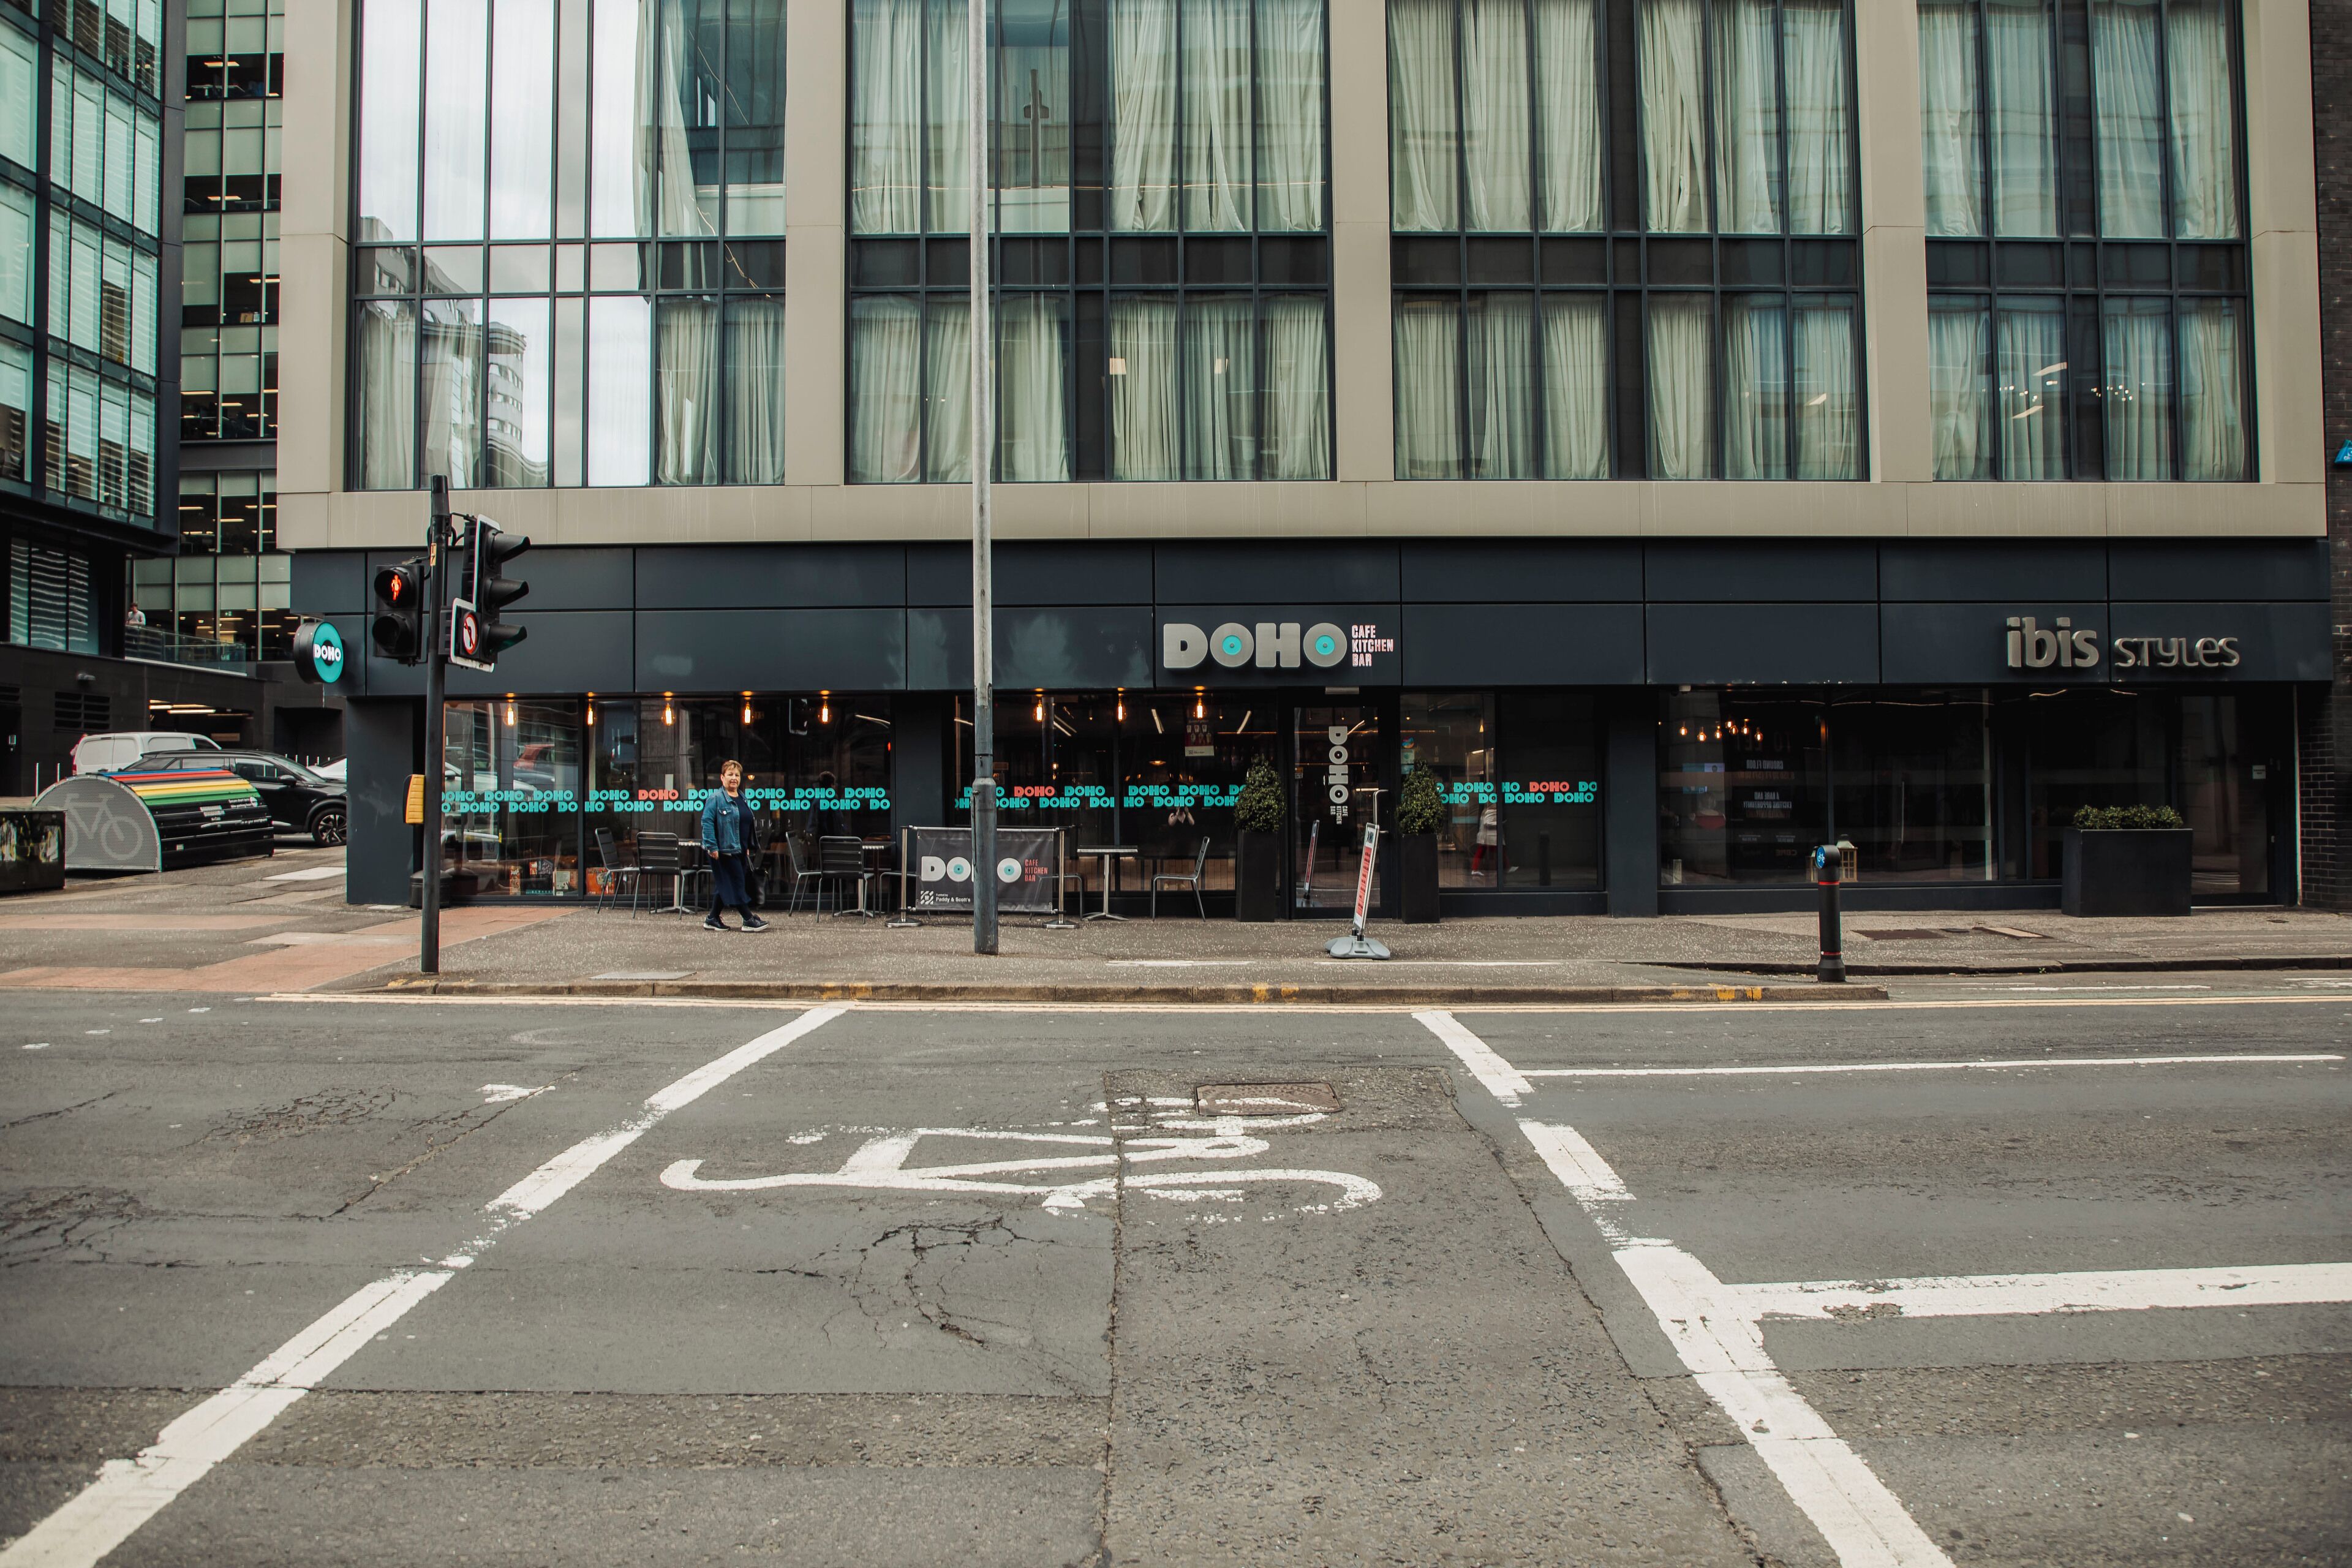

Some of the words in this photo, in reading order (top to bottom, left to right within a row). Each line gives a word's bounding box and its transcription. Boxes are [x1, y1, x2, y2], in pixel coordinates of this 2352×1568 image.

[1351, 625, 1376, 638] CAFE
[1164, 622, 1348, 668] DOHO
[1351, 639, 1393, 652] KITCHEN
[2007, 617, 2100, 668] ibis
[313, 644, 342, 662] DOHO
[1352, 653, 1372, 667] BAR
[1328, 726, 1348, 804] DOHO
[1014, 786, 1055, 797] DOHO
[1065, 786, 1106, 796] DOHO
[1129, 785, 1170, 796] DOHO
[1179, 785, 1219, 796] DOHO
[1453, 782, 1494, 793] DOHO
[1529, 782, 1570, 792] DOHO
[484, 790, 524, 801] DOHO
[533, 790, 574, 801] DOHO
[589, 790, 630, 801] DOHO
[638, 790, 679, 801] DOHO
[745, 788, 786, 799] DOHO
[795, 788, 835, 799] DOHO
[845, 788, 886, 799] DOHO
[1505, 793, 1545, 804] DOHO
[1554, 793, 1594, 803] DOHO
[460, 802, 501, 813] DOHO
[509, 802, 549, 813] DOHO
[614, 801, 654, 812] DOHO
[663, 801, 704, 812] DOHO
[770, 799, 811, 810] DOHO
[820, 799, 861, 810] DOHO
[1039, 797, 1080, 808] DOHO
[1154, 796, 1195, 807] DOHO
[921, 856, 1022, 883] DOO
